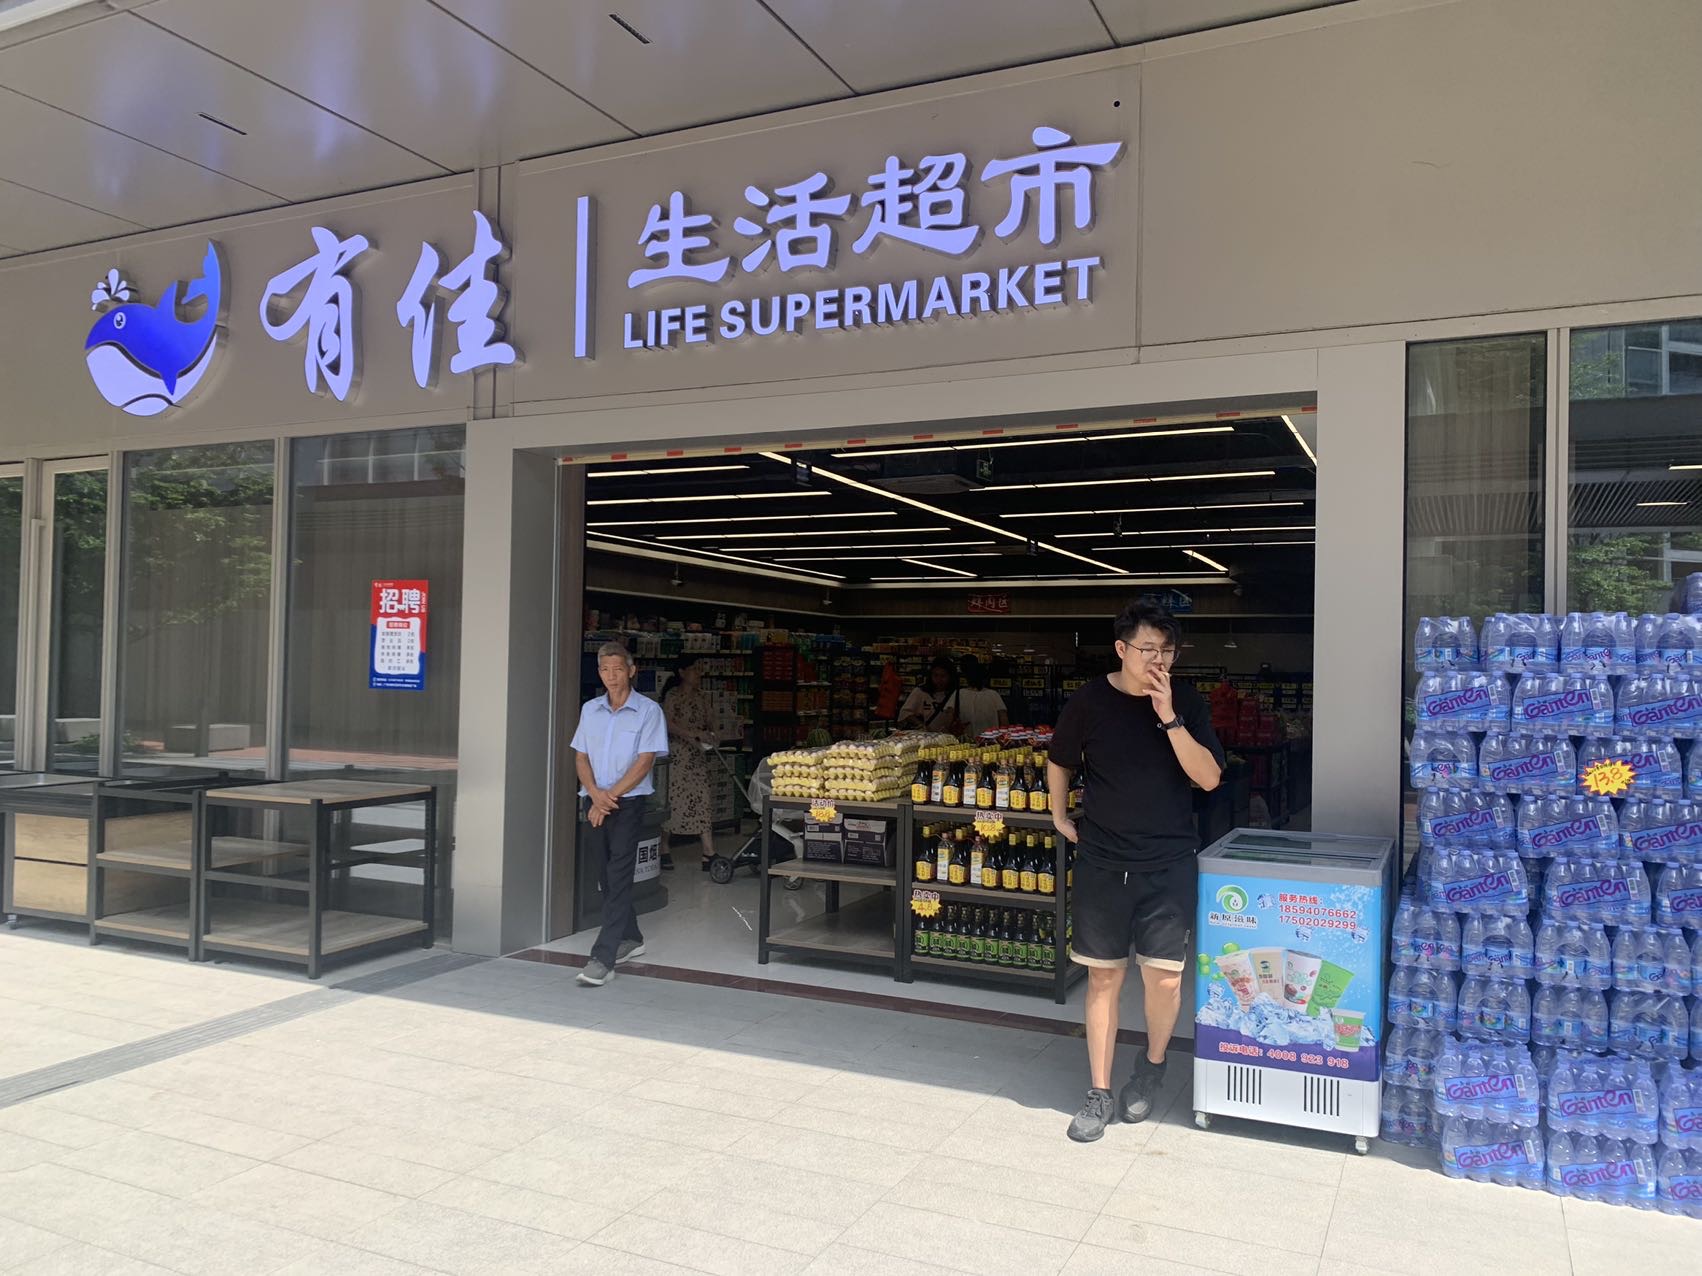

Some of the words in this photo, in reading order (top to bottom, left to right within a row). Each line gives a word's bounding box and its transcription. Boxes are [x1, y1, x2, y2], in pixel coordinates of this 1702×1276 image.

[627, 126, 1123, 289] 生活超市
[259, 209, 517, 401] 有佳
[623, 304, 708, 350] LIFE
[718, 256, 1102, 340] SUPERMARKET
[379, 588, 421, 613] 招聘
[1593, 767, 1623, 788] 13.8
[1279, 904, 1357, 919] 18594076662
[1279, 915, 1357, 930] 17502029299
[1267, 1048, 1297, 1062] 4008
[1327, 1056, 1349, 1069] 918
